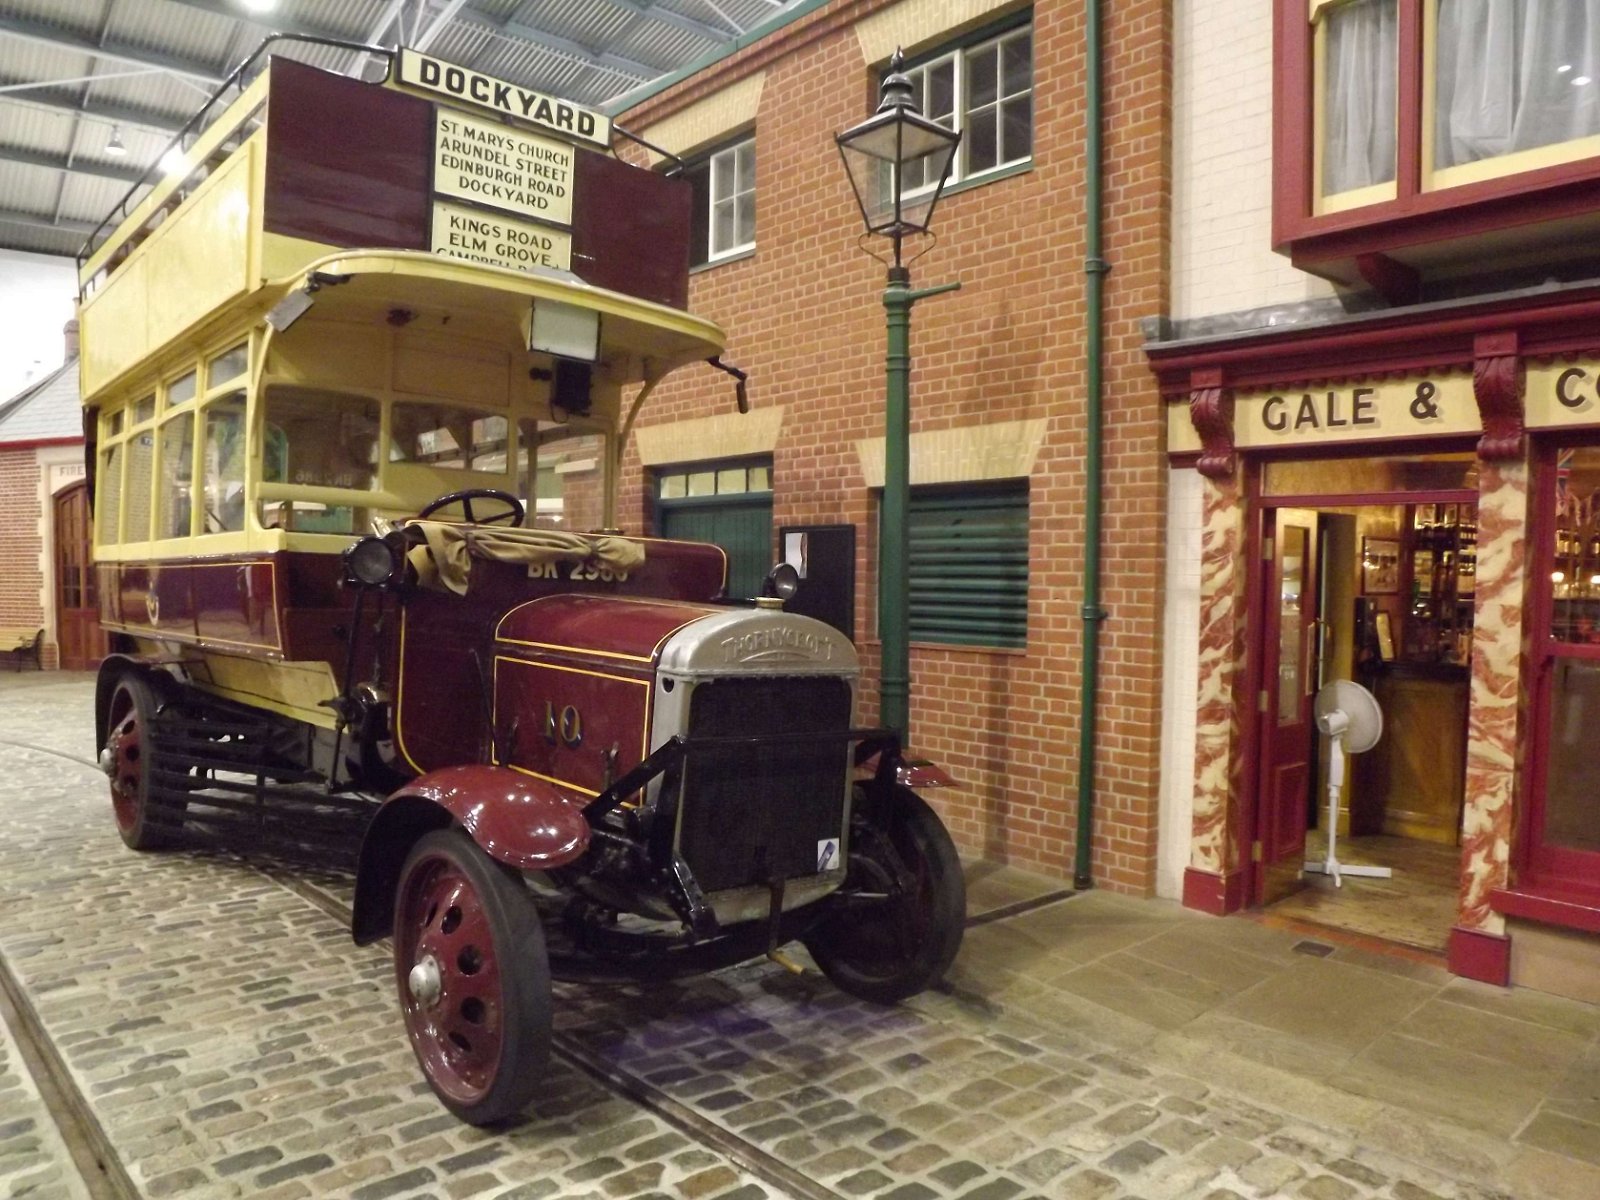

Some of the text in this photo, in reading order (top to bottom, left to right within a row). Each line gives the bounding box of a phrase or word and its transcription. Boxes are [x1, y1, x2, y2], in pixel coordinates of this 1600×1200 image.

[420, 58, 595, 137] DOCKYARD
[440, 137, 567, 182] ARUNDEL STREET
[518, 142, 569, 167] CHURCH
[441, 154, 565, 198] EDINBURGH ROAD
[458, 176, 549, 210] DOCKYARD
[449, 233, 487, 252] ELM
[450, 215, 552, 250] KINGS ROAD
[1262, 368, 1600, 431] GALE & C
[60, 466, 83, 476] FIRE
[543, 701, 581, 748] 10
